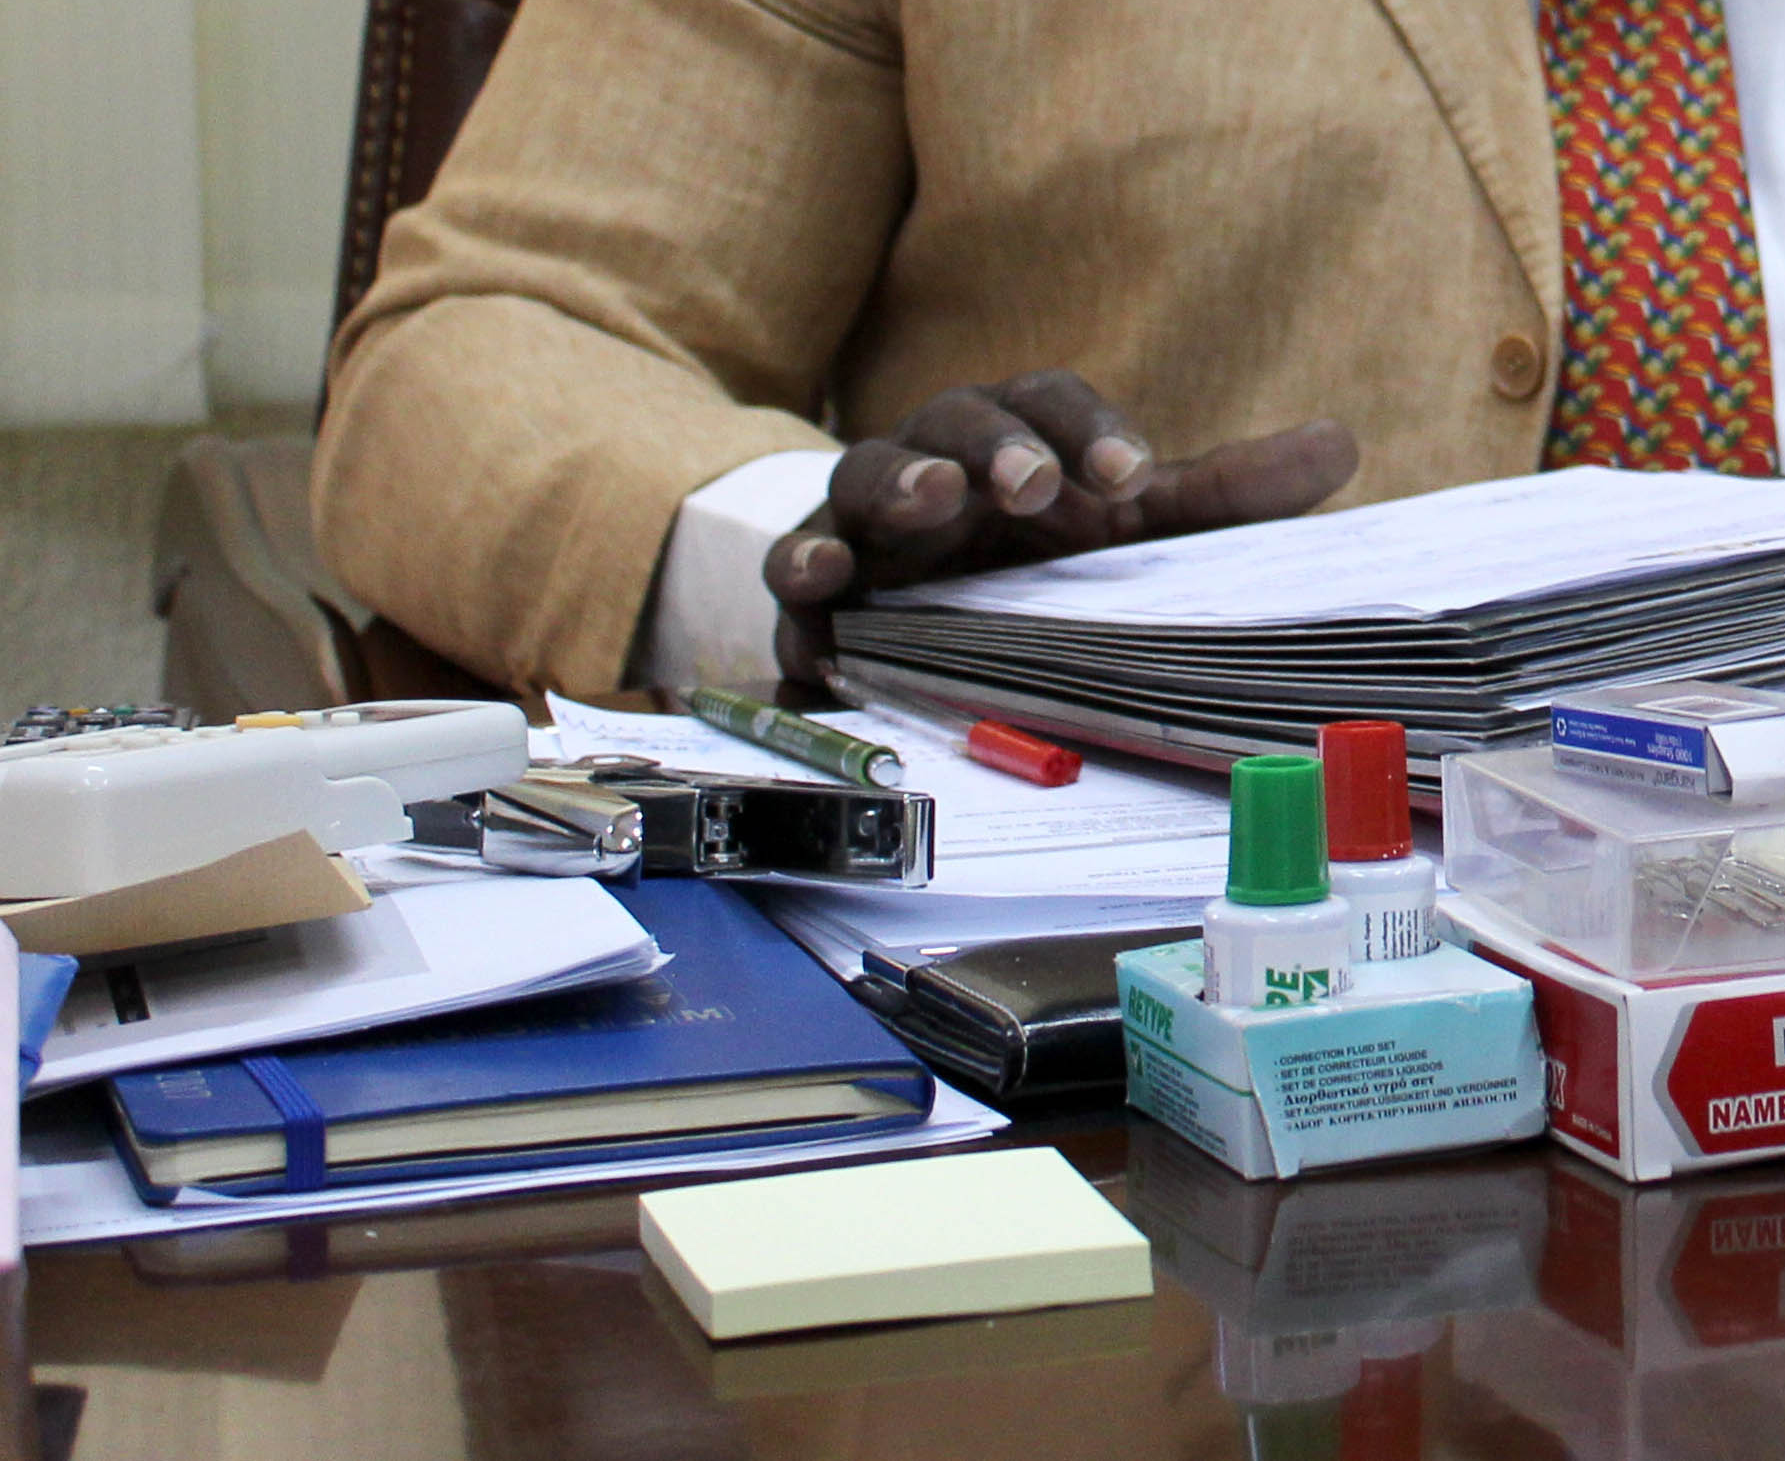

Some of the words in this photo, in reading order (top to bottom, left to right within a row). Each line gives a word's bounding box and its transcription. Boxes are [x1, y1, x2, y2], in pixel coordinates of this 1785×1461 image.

[1280, 1048, 1344, 1066] CORRECTION
[1346, 1044, 1375, 1057] FLUID
[1377, 1040, 1396, 1052] SET
[1280, 1068, 1299, 1080] SET
[1302, 1065, 1315, 1076] DE
[1318, 1056, 1386, 1074] CORRECTEUR
[1388, 1049, 1427, 1064] LIQUIDE
[1281, 1081, 1299, 1093] SET
[1303, 1078, 1316, 1089] DE
[1318, 1068, 1394, 1087] CORRECTORES
[1397, 1061, 1443, 1076] LIQUIDOS
[1433, 1085, 1453, 1098] UND
